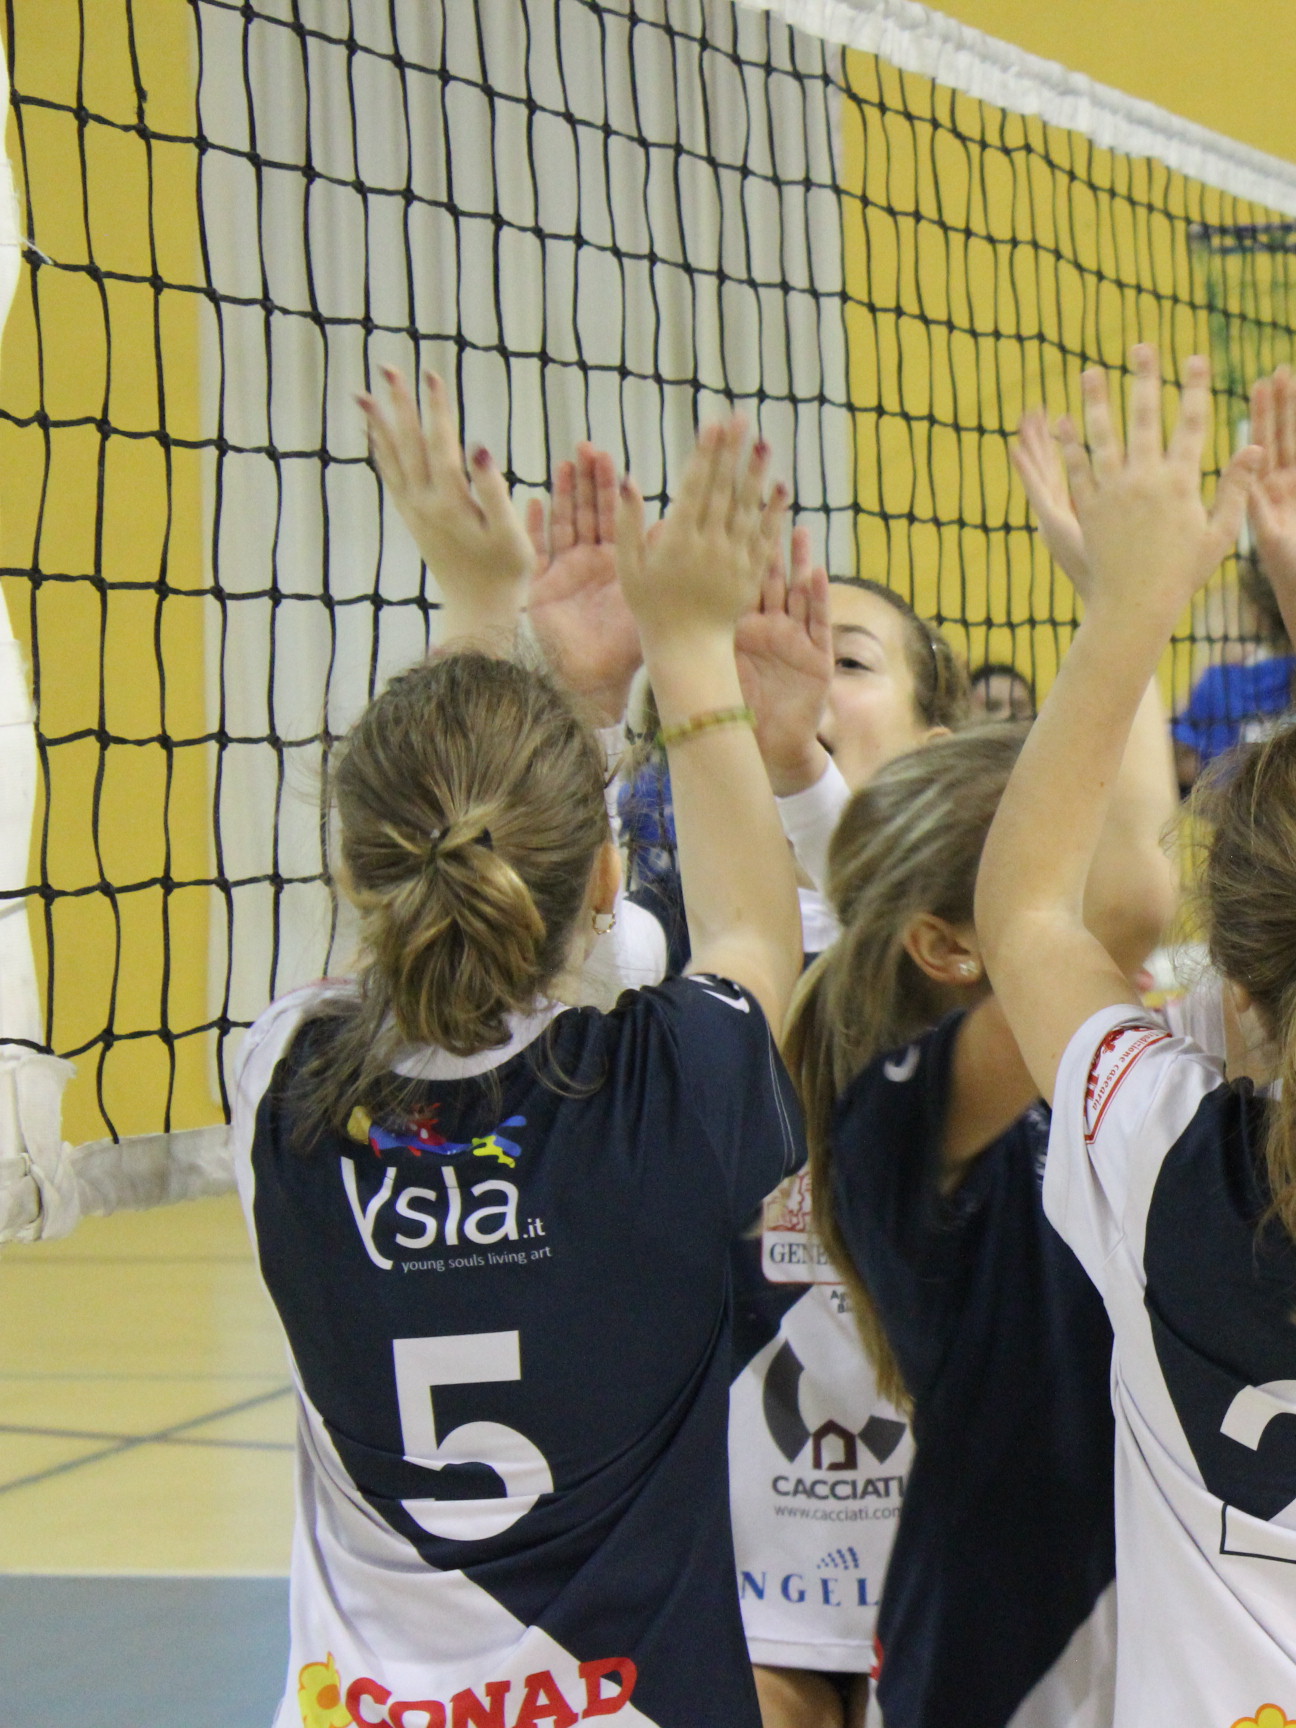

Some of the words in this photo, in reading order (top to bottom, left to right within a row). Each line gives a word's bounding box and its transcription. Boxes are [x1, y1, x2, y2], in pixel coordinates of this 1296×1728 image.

[401, 1258, 446, 1274] young
[448, 1253, 485, 1269] souls
[488, 1249, 527, 1266] living
[530, 1245, 553, 1261] art
[392, 1329, 555, 1542] 5
[771, 1474, 905, 1501] CACCIATI
